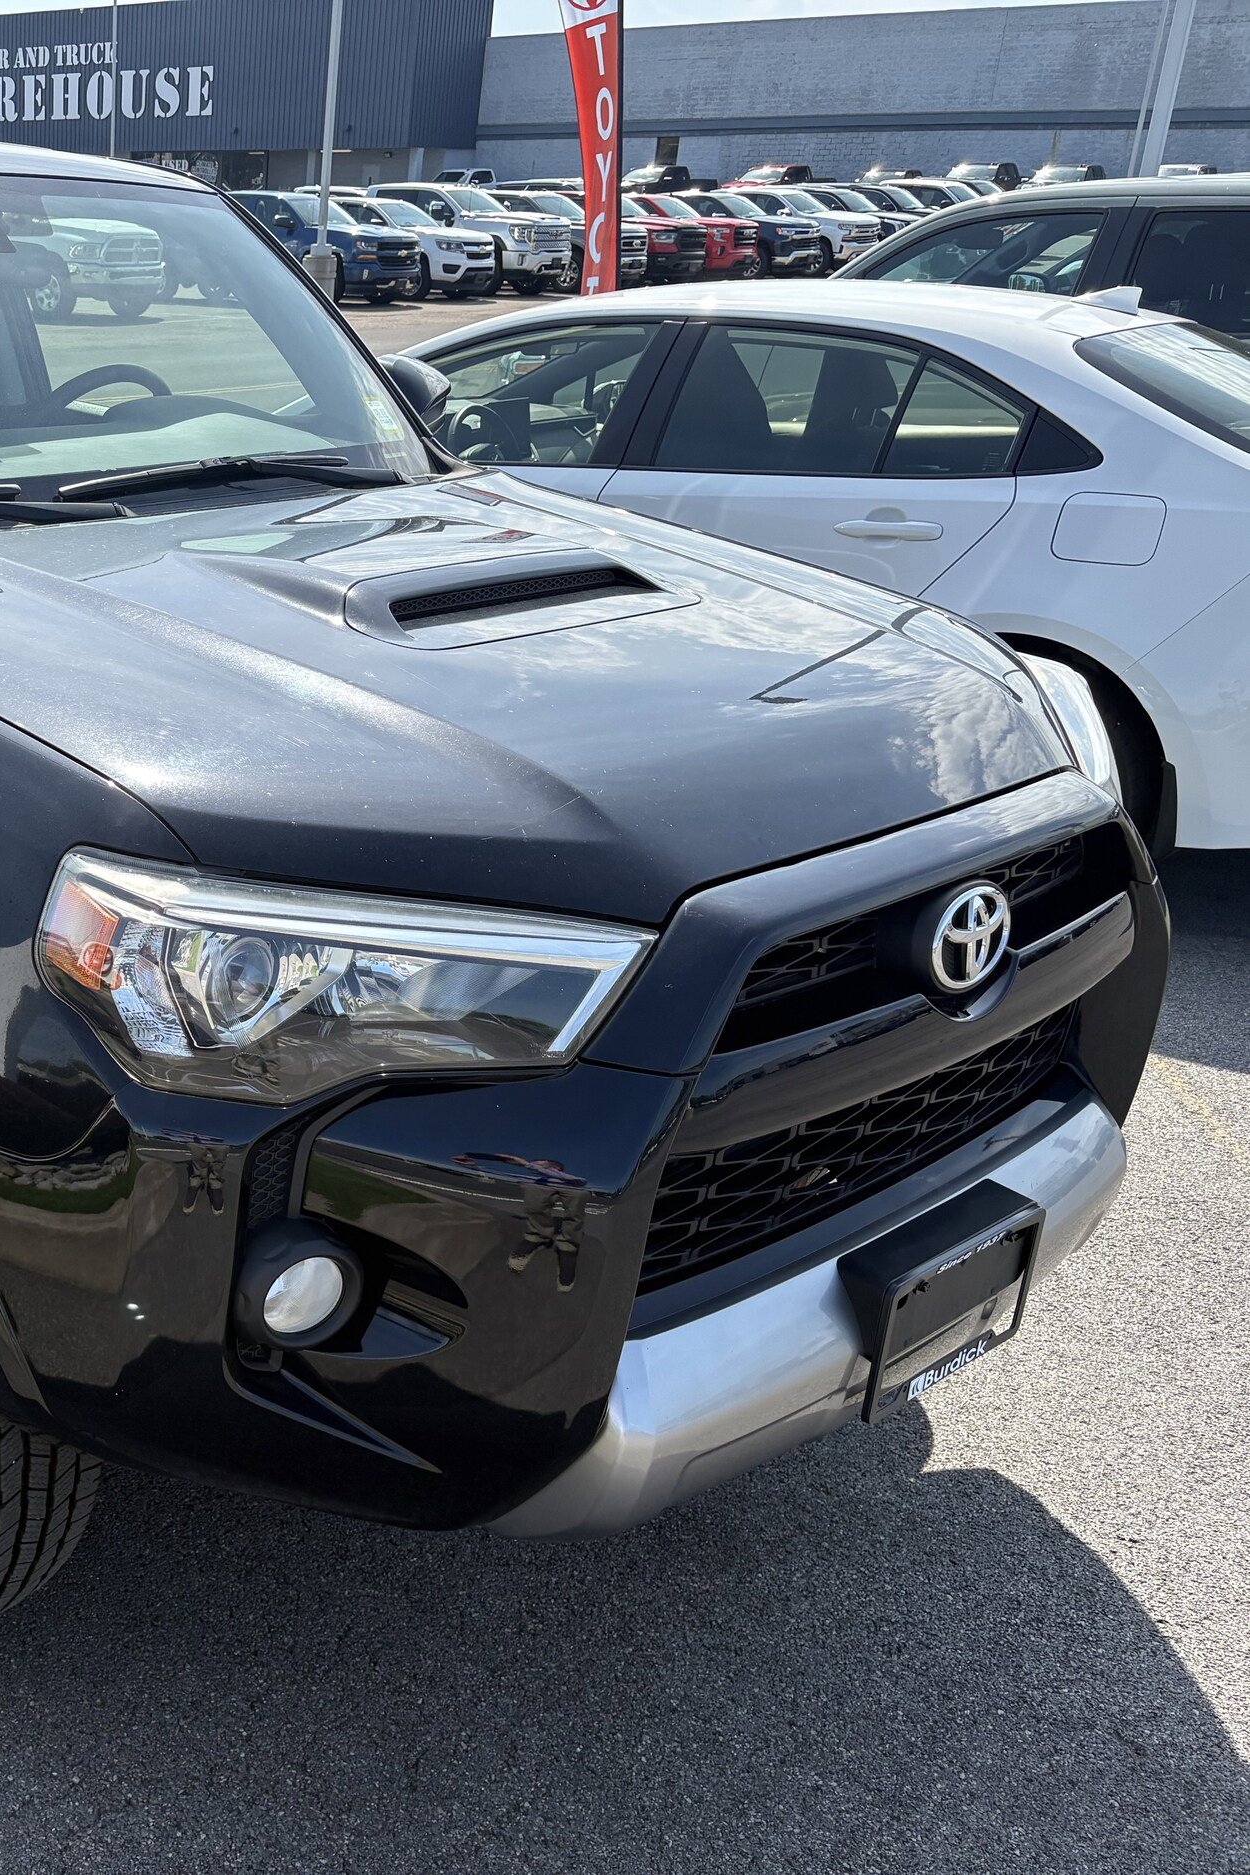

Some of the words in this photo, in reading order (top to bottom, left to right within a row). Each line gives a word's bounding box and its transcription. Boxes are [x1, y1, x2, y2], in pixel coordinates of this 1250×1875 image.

[13, 45, 50, 69] AND
[54, 41, 119, 67] TRUCK
[161, 159, 189, 171] USED
[935, 1250, 973, 1275] Since
[923, 1339, 988, 1389] Burdick
